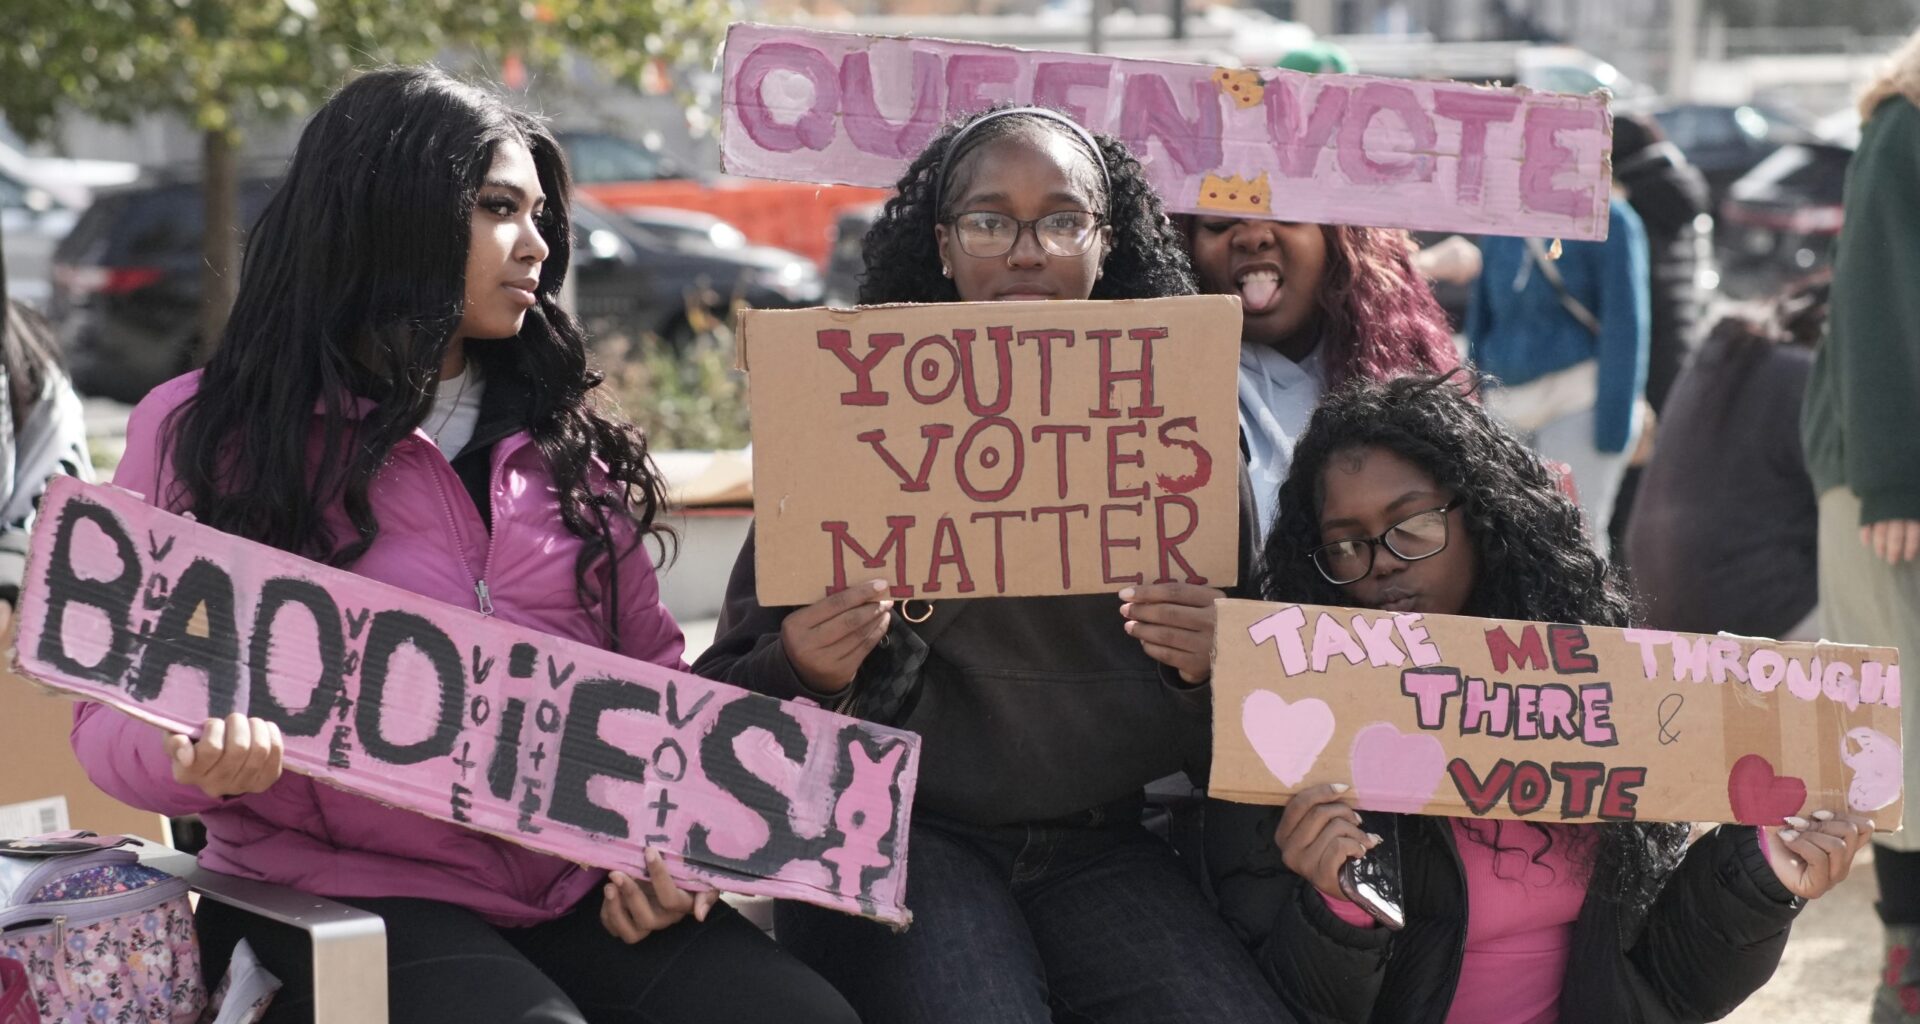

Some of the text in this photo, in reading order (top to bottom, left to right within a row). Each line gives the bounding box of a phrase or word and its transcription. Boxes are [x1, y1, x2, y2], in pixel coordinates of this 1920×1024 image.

[1266, 67, 1600, 218] VOTE
[816, 325, 1168, 418] YOUTH
[857, 416, 1213, 502] VOTES
[821, 494, 1209, 599] MATTER
[1248, 605, 1900, 712] TAKE ME THROUGH
[1400, 667, 1684, 748] THERE &
[1445, 757, 1647, 820] VOTE
